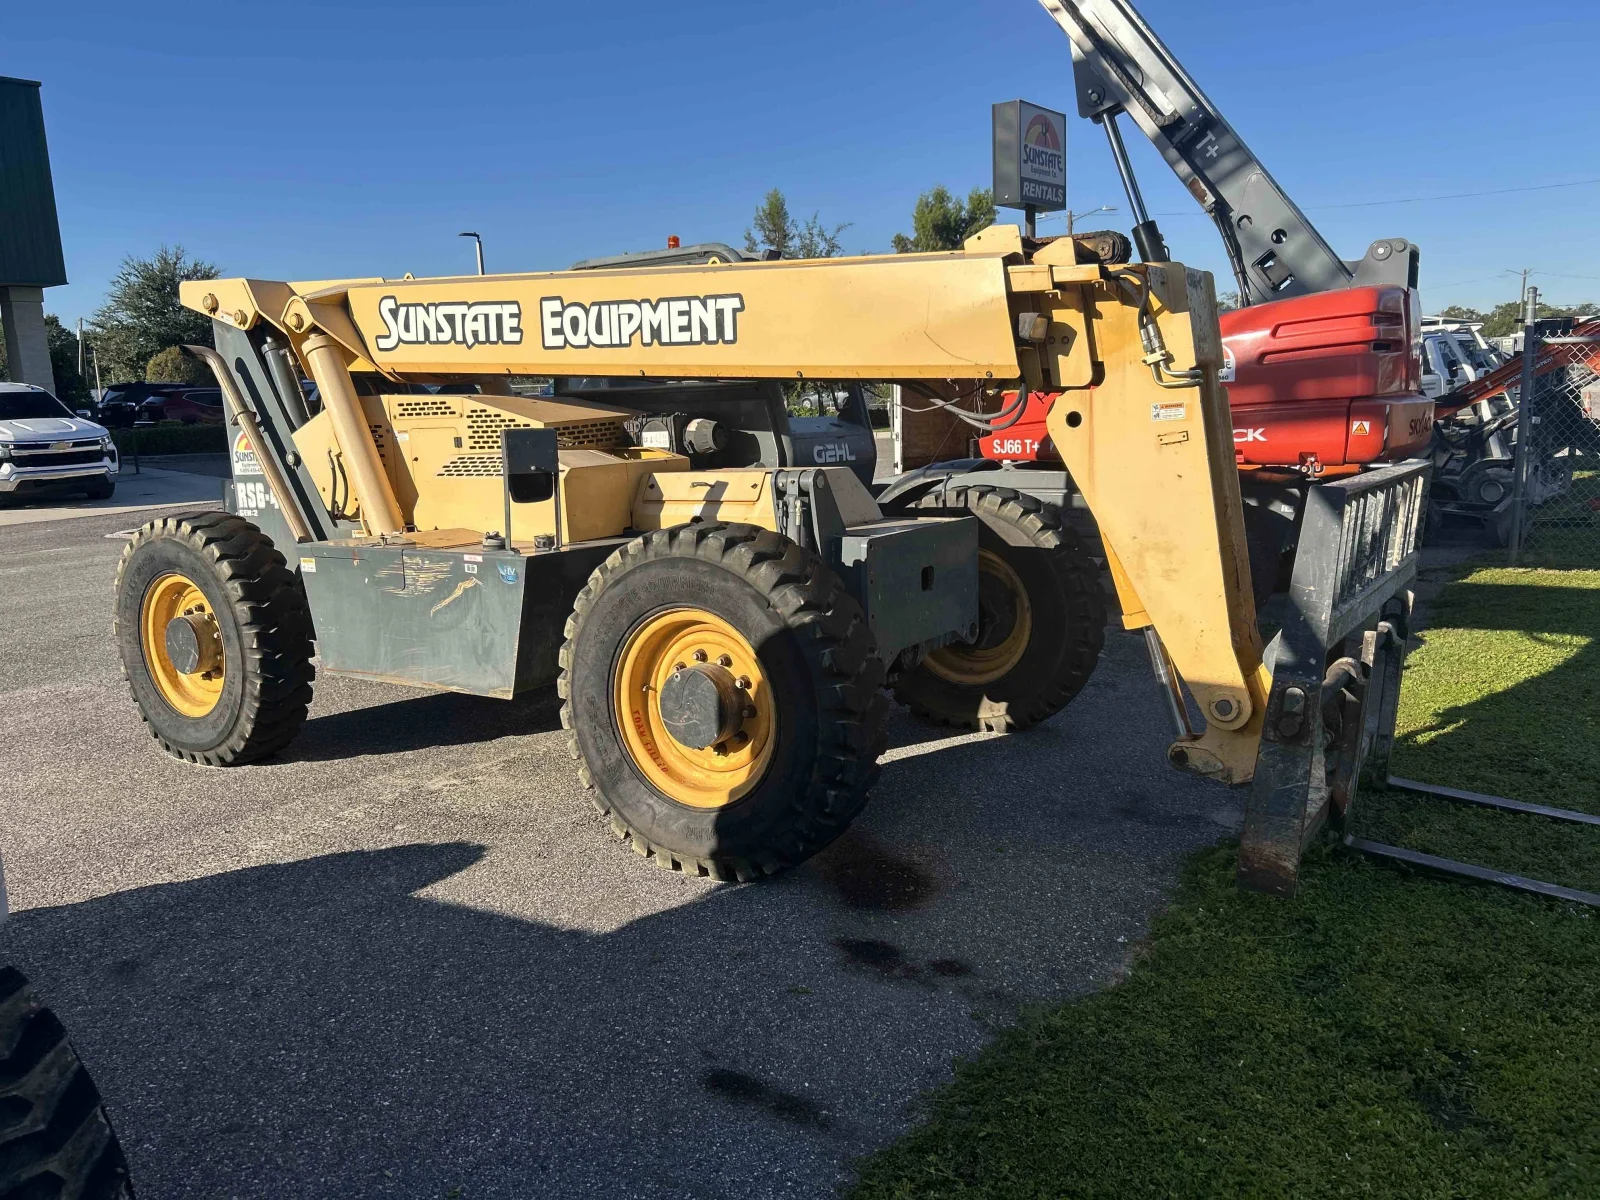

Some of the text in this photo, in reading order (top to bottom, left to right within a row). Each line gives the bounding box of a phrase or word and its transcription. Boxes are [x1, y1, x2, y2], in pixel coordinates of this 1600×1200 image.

[1023, 143, 1063, 172] SUNSTATE
[1196, 130, 1219, 158] T+
[1023, 181, 1064, 202] RENTALS
[376, 294, 743, 350] SUNSTATE EQUIPMENT
[813, 443, 856, 463] GEHL
[993, 439, 1040, 454] SJ66 T+
[633, 709, 669, 773] FOAM FILLED
